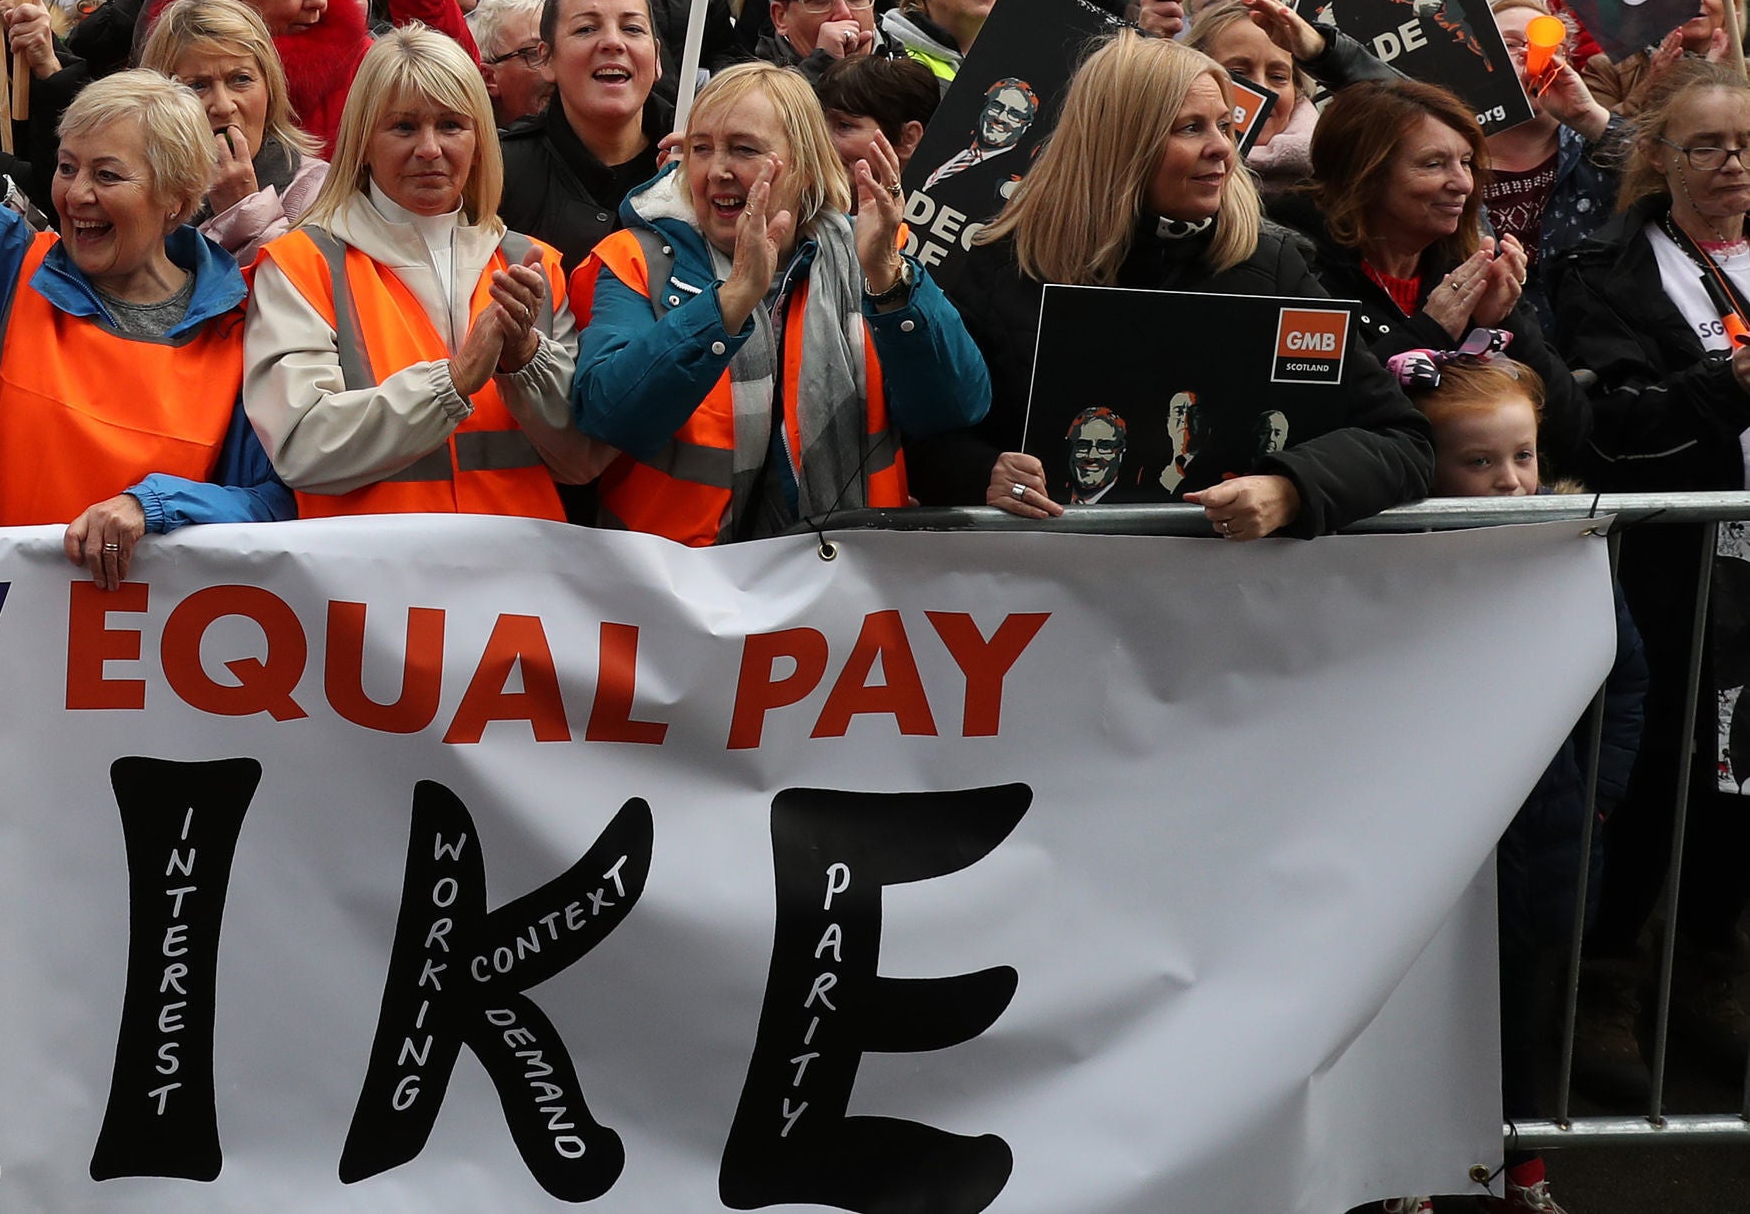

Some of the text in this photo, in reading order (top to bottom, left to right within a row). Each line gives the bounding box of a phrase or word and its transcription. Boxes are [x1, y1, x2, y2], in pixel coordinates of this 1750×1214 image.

[1286, 331, 1336, 352] GMB
[1286, 362, 1330, 372] SCOTLAND
[65, 580, 669, 746] EQUAL
[726, 609, 1052, 750] PAY
[148, 807, 196, 1115] INTEREST
[392, 832, 466, 1111] WORKING
[471, 855, 628, 982] CONTEXT
[781, 862, 850, 1137] PARITY
[486, 1008, 586, 1158] DEMAND
